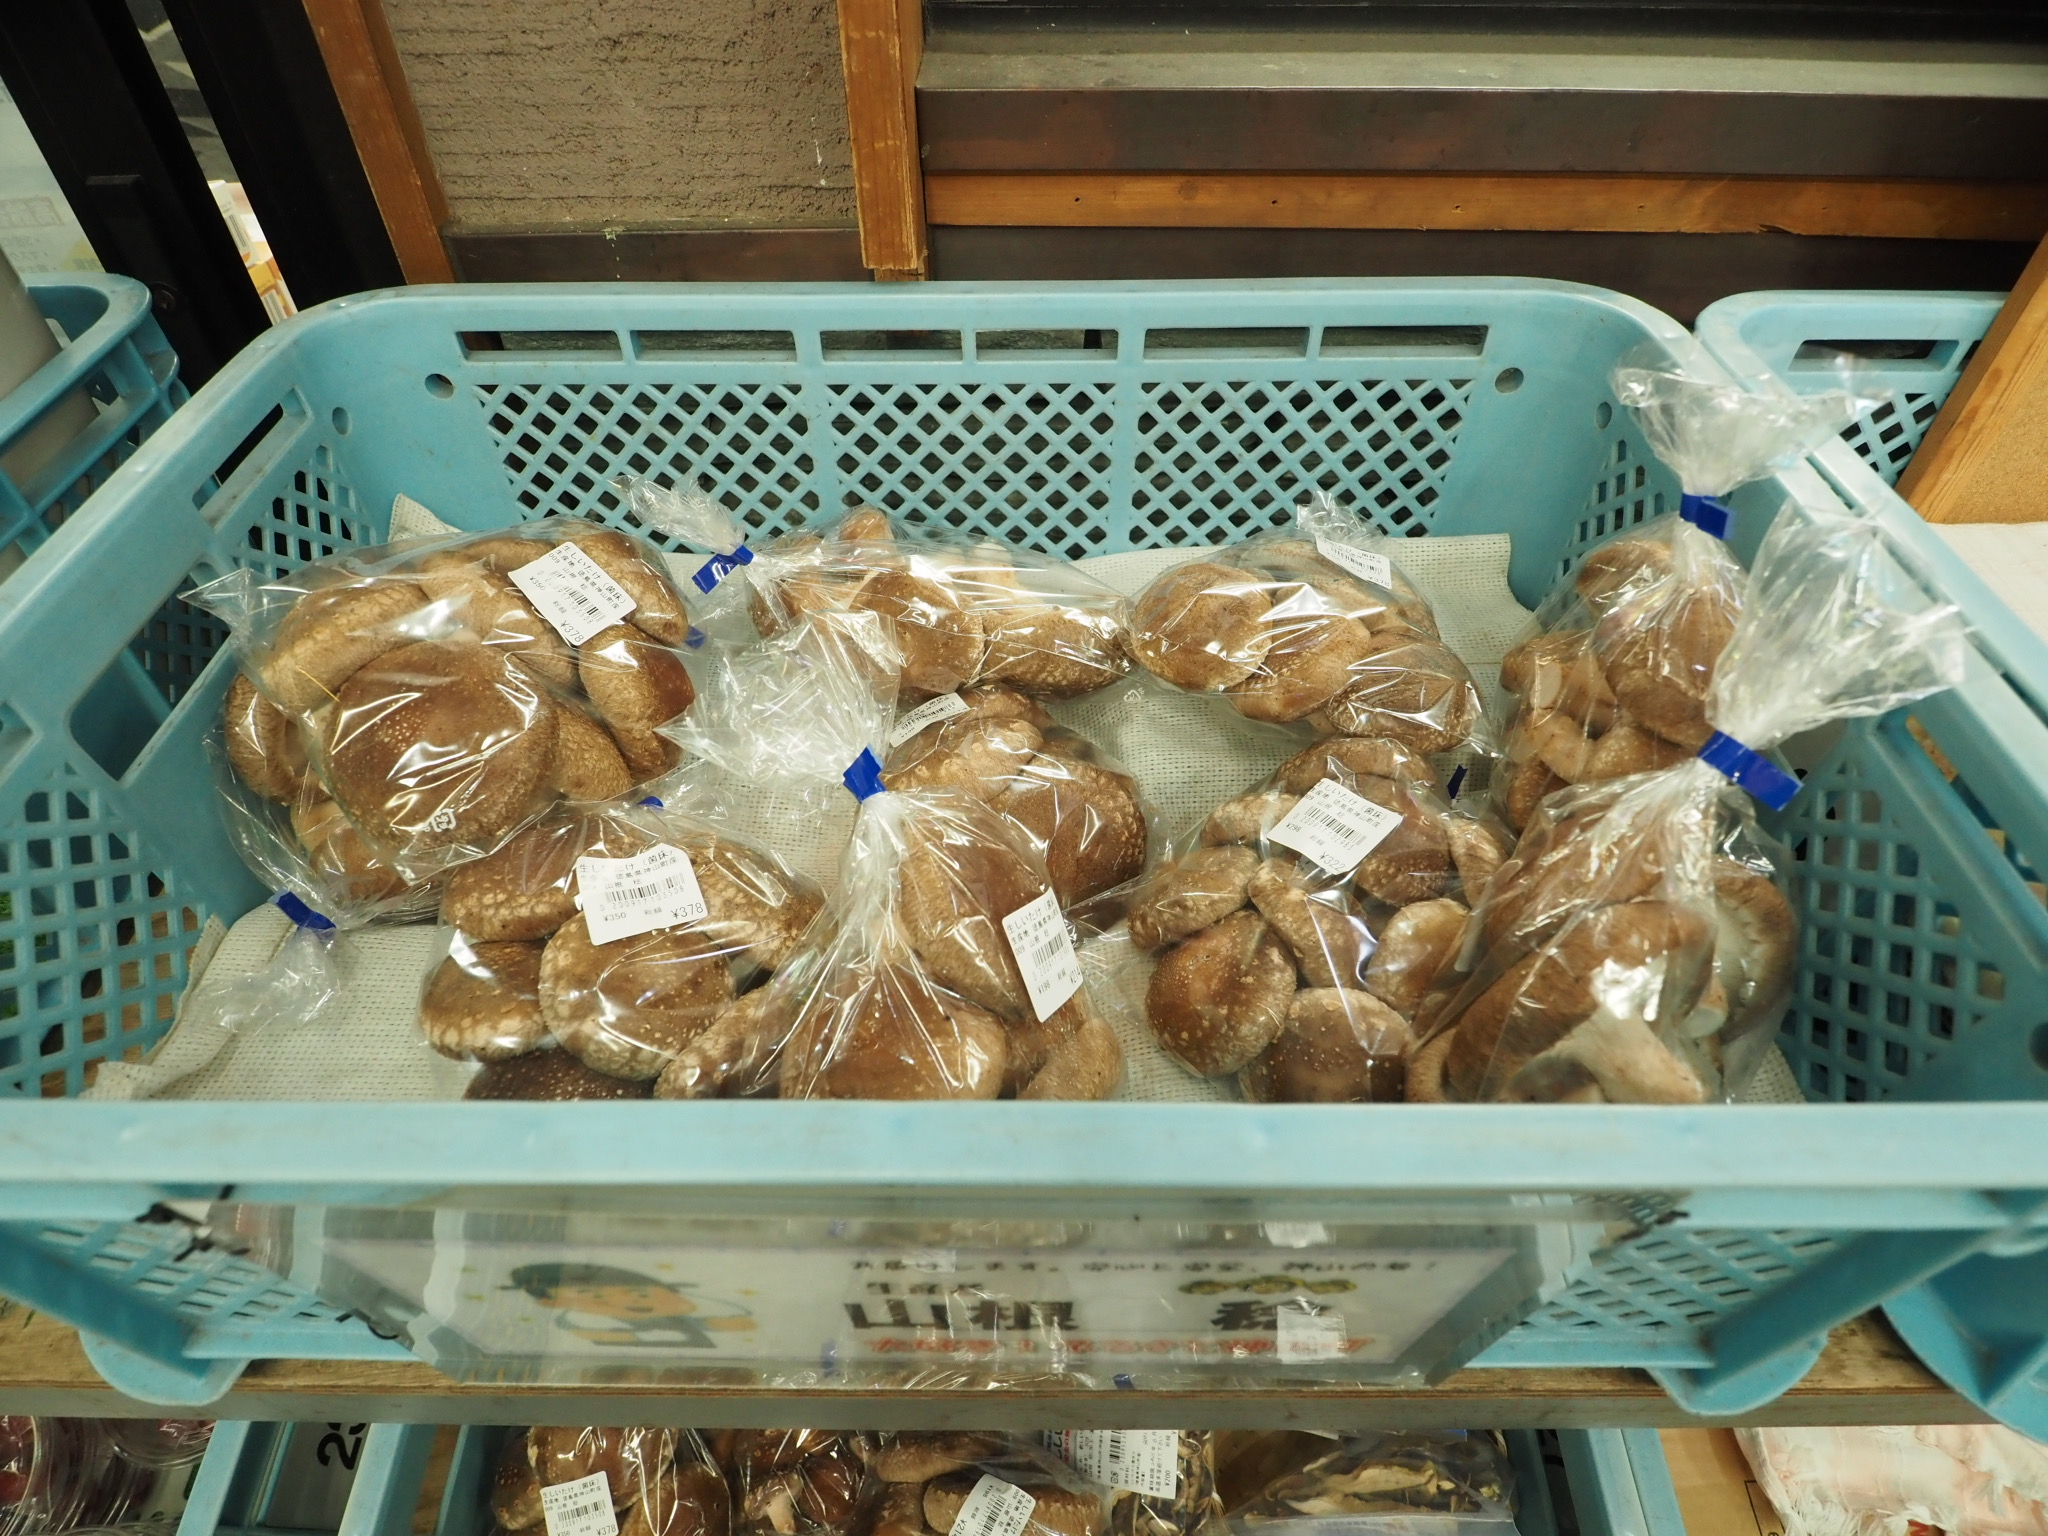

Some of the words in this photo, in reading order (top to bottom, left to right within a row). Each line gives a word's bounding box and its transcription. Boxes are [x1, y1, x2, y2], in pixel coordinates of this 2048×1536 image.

[529, 576, 546, 591] ¥350
[560, 620, 584, 643] ¥378
[580, 850, 673, 872] 生しけ（菌床）
[1320, 852, 1345, 872] ¥322
[603, 912, 626, 922] ¥350
[671, 902, 704, 919] ¥378
[596, 1524, 617, 1536] ¥378
